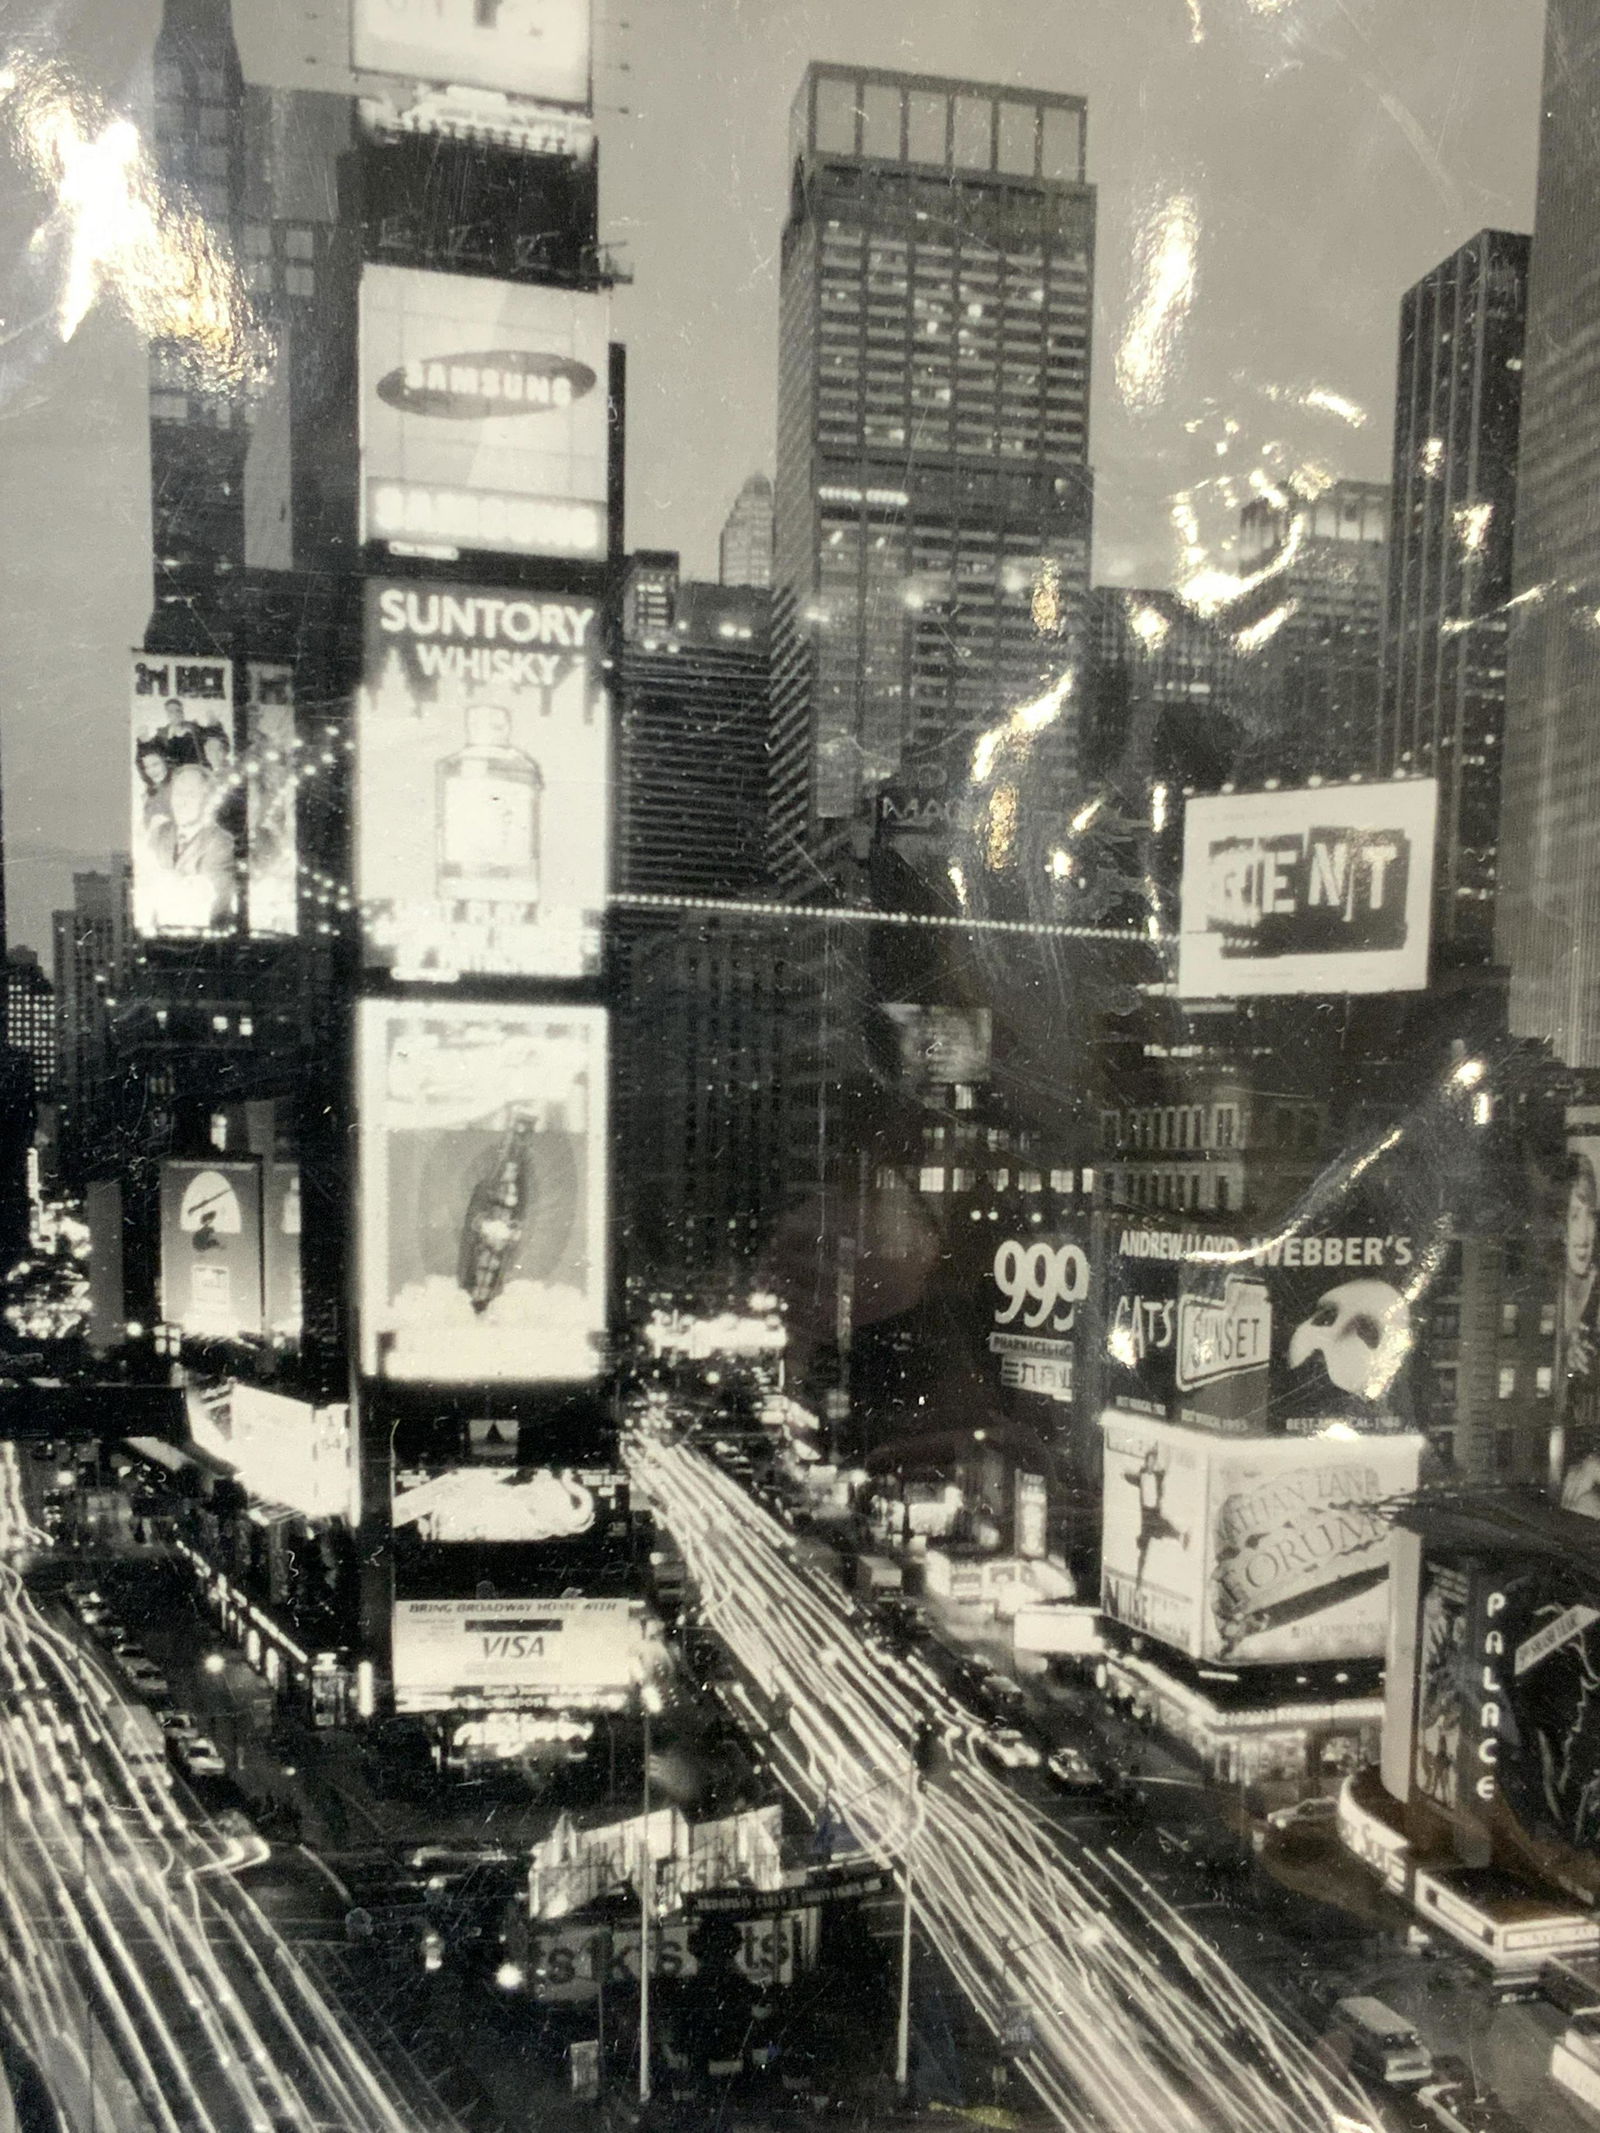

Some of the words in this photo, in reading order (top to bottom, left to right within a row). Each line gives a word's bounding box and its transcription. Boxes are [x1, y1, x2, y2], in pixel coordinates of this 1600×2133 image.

[404, 359, 572, 408] SAMSUNG
[380, 588, 594, 646] SUNTORY
[416, 643, 561, 685] WHISKY
[1210, 842, 1397, 925] RENT
[1119, 1231, 1182, 1260] ANDREW
[1251, 1236, 1413, 1267] WEBBER'S
[994, 1240, 1090, 1332] 999
[1113, 1295, 1174, 1359] CATS
[1191, 1314, 1260, 1368] SUNSET
[457, 1602, 535, 1613] BROADWAY
[482, 1635, 545, 1658] VISA
[1476, 1592, 1506, 1800] PALACE
